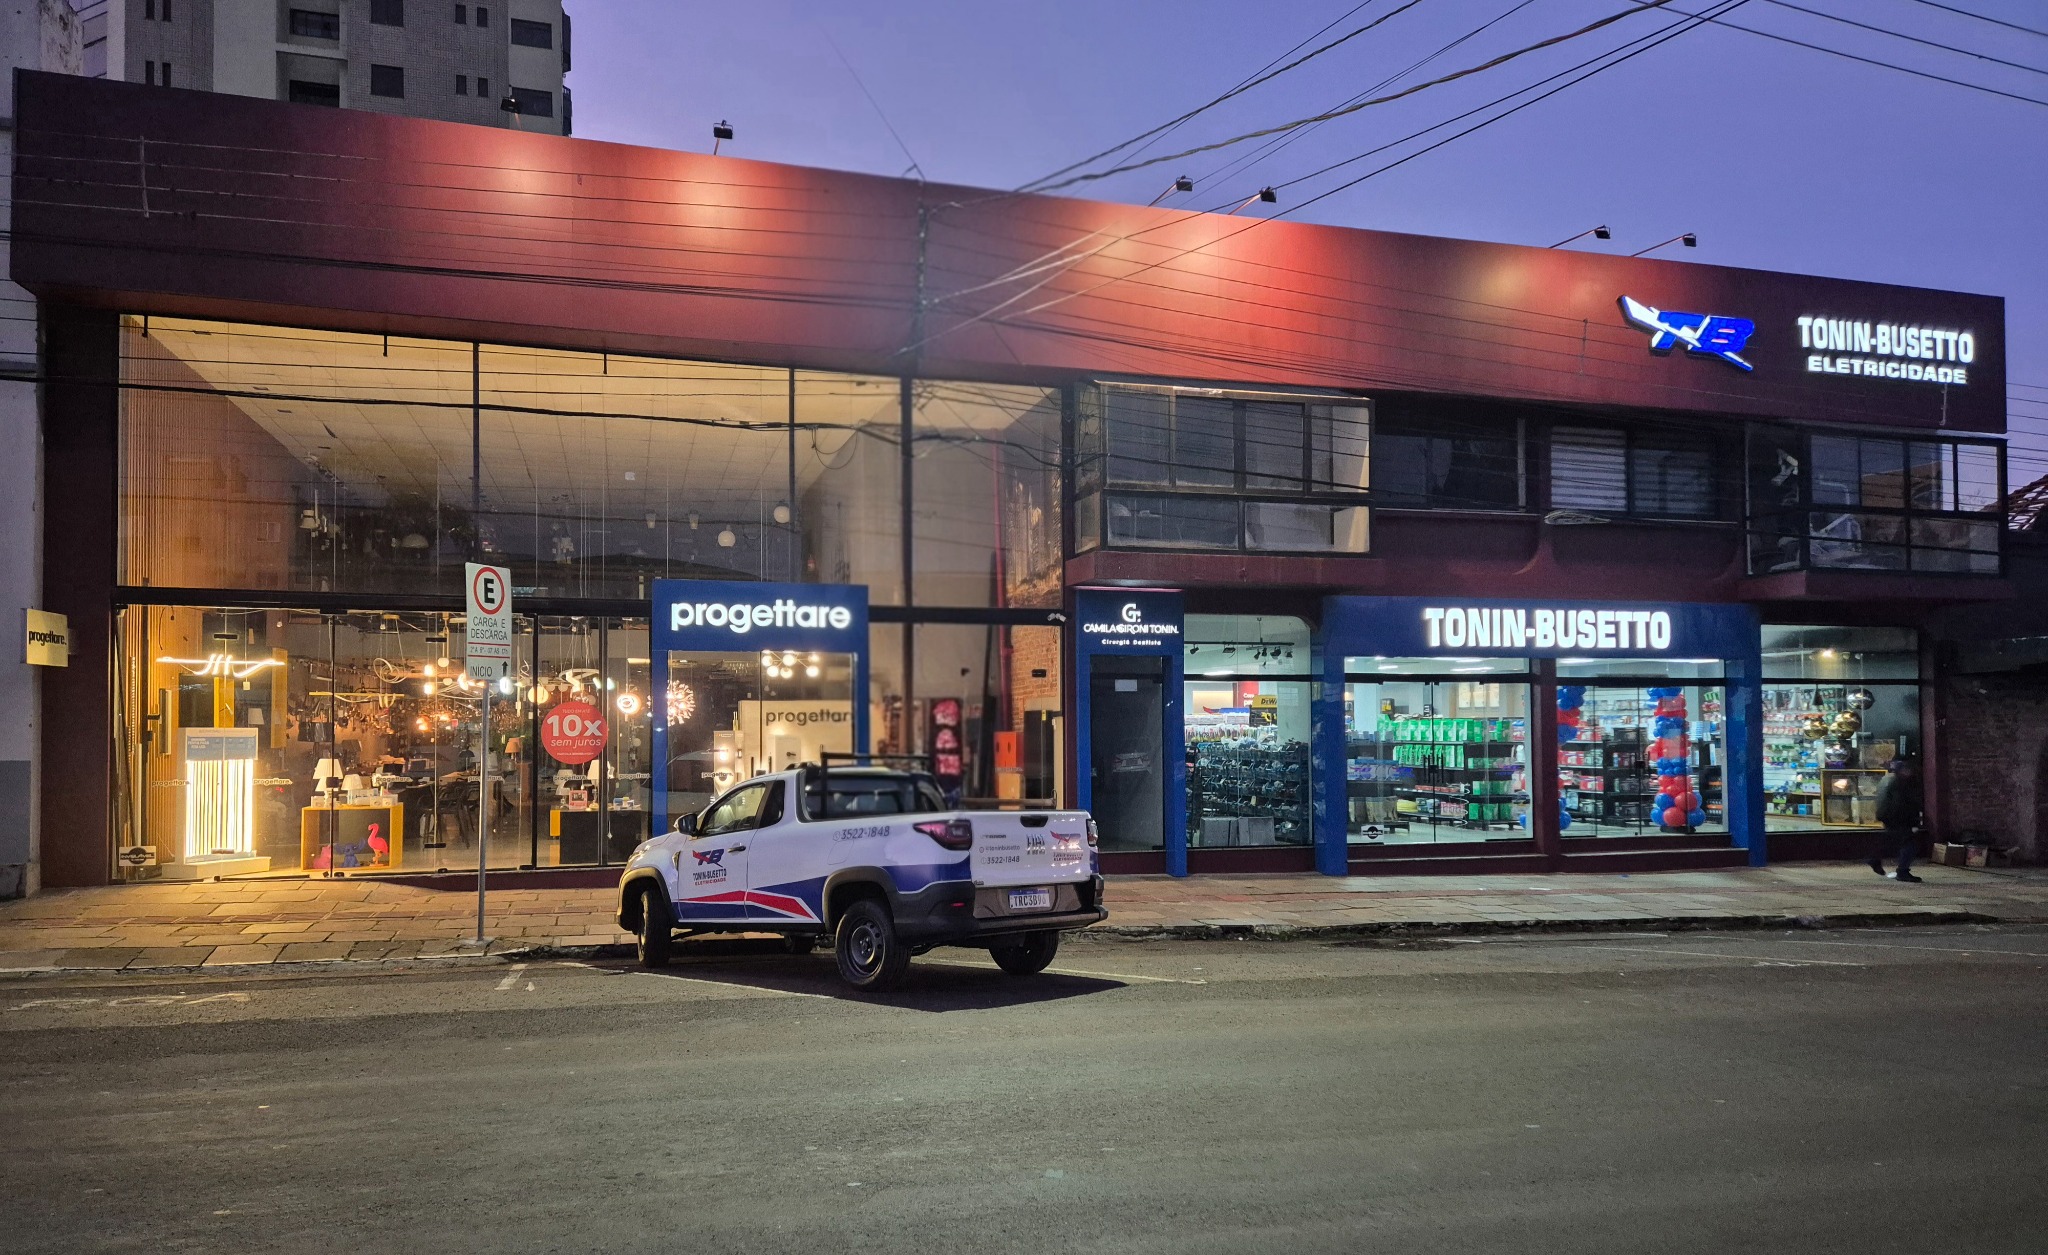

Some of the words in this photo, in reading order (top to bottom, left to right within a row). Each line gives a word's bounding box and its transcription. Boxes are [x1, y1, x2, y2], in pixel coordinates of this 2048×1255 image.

[1797, 316, 1976, 364] TONIN-BUSETTO
[1807, 355, 1968, 385] ELETRICIDADE
[483, 577, 496, 604] E
[472, 616, 498, 628] CARGA
[501, 619, 506, 628] E
[671, 599, 852, 634] progettare
[470, 628, 508, 640] DESCARGA
[1083, 623, 1117, 633] CAMILA
[1116, 624, 1149, 635] GIRONI
[1425, 607, 1671, 649] TONIN-BUSETTO
[766, 709, 853, 726] progettar
[547, 714, 603, 737] 10x
[551, 739, 572, 747] sem
[573, 737, 601, 749] juros
[841, 826, 890, 839] 3522-1848
[987, 856, 1020, 864] 3522-1848
[693, 868, 727, 881] TONIN-BUSETTO
